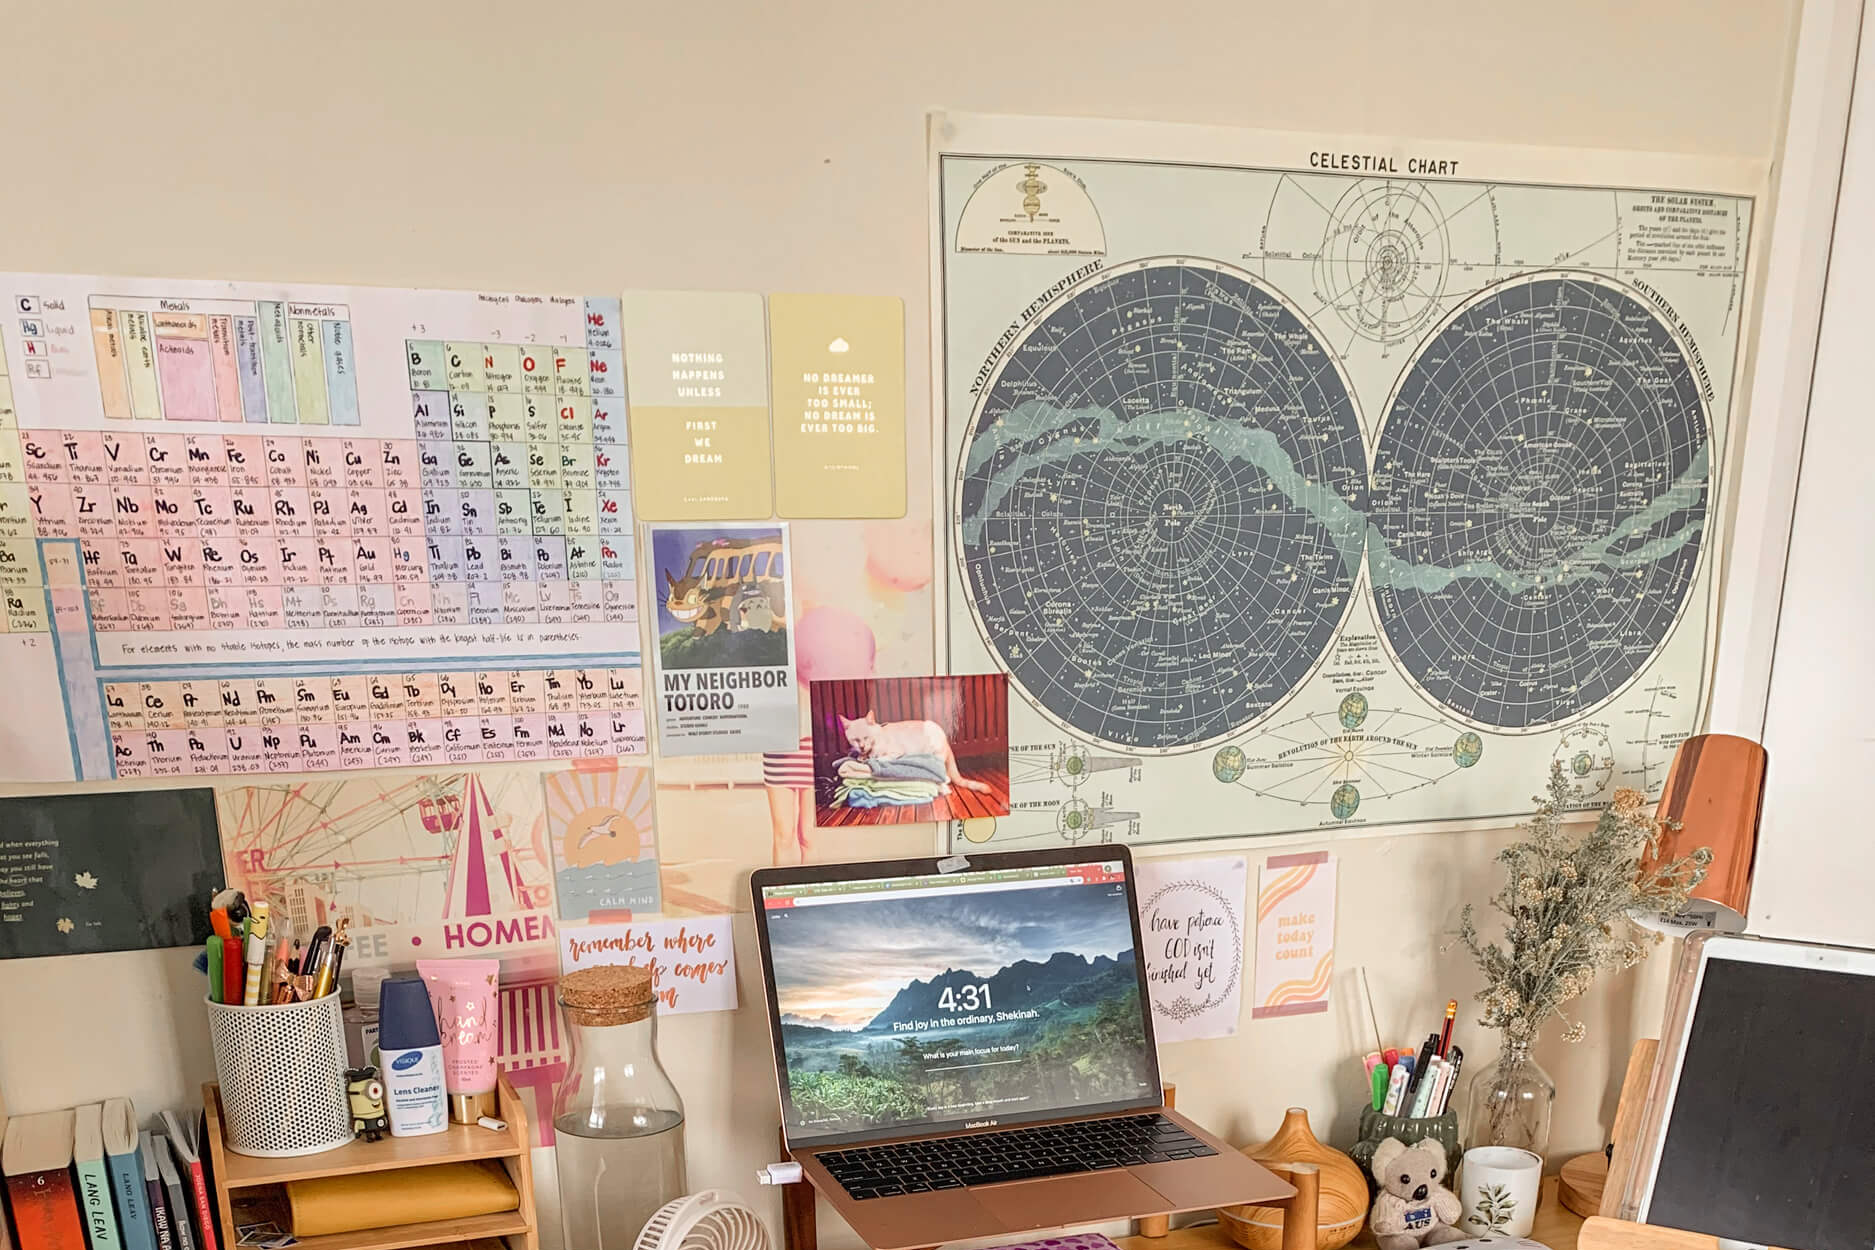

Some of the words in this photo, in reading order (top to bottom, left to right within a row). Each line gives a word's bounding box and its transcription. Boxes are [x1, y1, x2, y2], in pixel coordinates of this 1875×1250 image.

[1310, 152, 1398, 172] CELESTIAL
[1408, 158, 1459, 176] CHART
[20, 298, 30, 312] C
[289, 306, 336, 318] Nonmetals
[969, 321, 1022, 397] NORTHERN
[1020, 258, 1104, 323] HEMISPHERE
[1632, 278, 1680, 324] SOUTHERN
[1678, 322, 1716, 402] HEMISPHERE
[410, 352, 422, 366] B
[485, 356, 494, 368] N
[523, 358, 536, 372] O
[556, 358, 566, 372] F
[672, 353, 723, 363] NOTHING
[672, 371, 724, 380] HAPPENS
[803, 373, 820, 383] NO
[823, 374, 874, 384] DREAMER
[678, 387, 721, 397] UNLESS
[818, 386, 828, 396] IS
[832, 386, 860, 396] EVER
[807, 398, 828, 408] TOO
[414, 405, 429, 418] Al
[560, 407, 574, 420] Cl
[804, 411, 820, 420] NO
[824, 412, 861, 421] DREAM
[864, 412, 875, 421] IS
[686, 421, 717, 430] FIRST
[800, 424, 828, 433] EVER
[832, 424, 853, 433] TOO
[857, 424, 879, 433] BIG.
[694, 438, 710, 447] WE
[25, 444, 46, 459] Sc
[64, 443, 79, 460] Ti
[105, 444, 120, 462] V
[150, 448, 168, 462] Cr
[189, 448, 210, 462] Mn
[228, 450, 244, 463] Fe
[269, 450, 286, 462] Co
[306, 448, 320, 464] Ni
[384, 451, 400, 466] Zn
[346, 453, 362, 467] Cu
[684, 454, 722, 464] DREAM
[117, 497, 139, 513] Nb
[155, 500, 178, 514] Mo
[274, 500, 294, 516] Rh
[314, 499, 330, 516] Pd
[351, 502, 368, 515] Ag
[392, 502, 408, 514] Cd
[240, 550, 258, 564] Os
[356, 548, 376, 560] Au
[122, 644, 135, 654] For
[140, 644, 177, 654] elements
[184, 644, 202, 652] with
[286, 639, 299, 648] the
[304, 640, 322, 648] mass
[326, 638, 354, 647] number
[372, 637, 386, 646] the
[664, 673, 692, 692] MY
[696, 670, 788, 690] NEIGHBOR
[224, 692, 240, 706] Nd
[664, 692, 734, 712] TOTORO
[1278, 740, 1319, 760] REVOLUTION
[1330, 736, 1342, 744] THE
[1343, 735, 1364, 743] EARTH
[1366, 736, 1392, 744] AROUND
[1392, 738, 1406, 747] THE
[1405, 740, 1418, 750] SUN
[600, 898, 625, 906] CALM
[630, 896, 654, 904] MIND
[1151, 908, 1180, 932] have
[1187, 910, 1224, 936] patience
[1278, 912, 1316, 928] make
[569, 928, 655, 962] remember
[664, 926, 716, 954] where
[1277, 930, 1314, 944] today
[1164, 937, 1190, 959] GOD
[1276, 945, 1314, 960] count
[674, 960, 728, 984] comes
[1194, 962, 1216, 990] yet
[938, 984, 992, 1012] 4:31
[438, 996, 488, 1032] hand
[893, 1020, 914, 1032] Find
[914, 1018, 928, 1031] joy
[930, 1018, 939, 1028] in
[940, 1016, 956, 1027] the
[957, 1014, 996, 1025] ordinary,
[996, 1009, 1040, 1022] Shekinah.
[922, 1052, 938, 1060] What
[946, 1052, 958, 1060] your
[974, 1047, 990, 1055] focus
[1000, 1044, 1020, 1053] today?
[394, 1088, 411, 1096] Lens
[413, 1085, 440, 1095] Cleaner
[37, 1176, 44, 1186] 6
[122, 1172, 132, 1196] LANG
[128, 1198, 136, 1220] LEAV
[84, 1174, 100, 1206] LANG
[92, 1211, 108, 1240] LEAV
[155, 1206, 168, 1230] IKAW
[1404, 1219, 1430, 1230] AUS
[160, 1230, 170, 1244] NA
